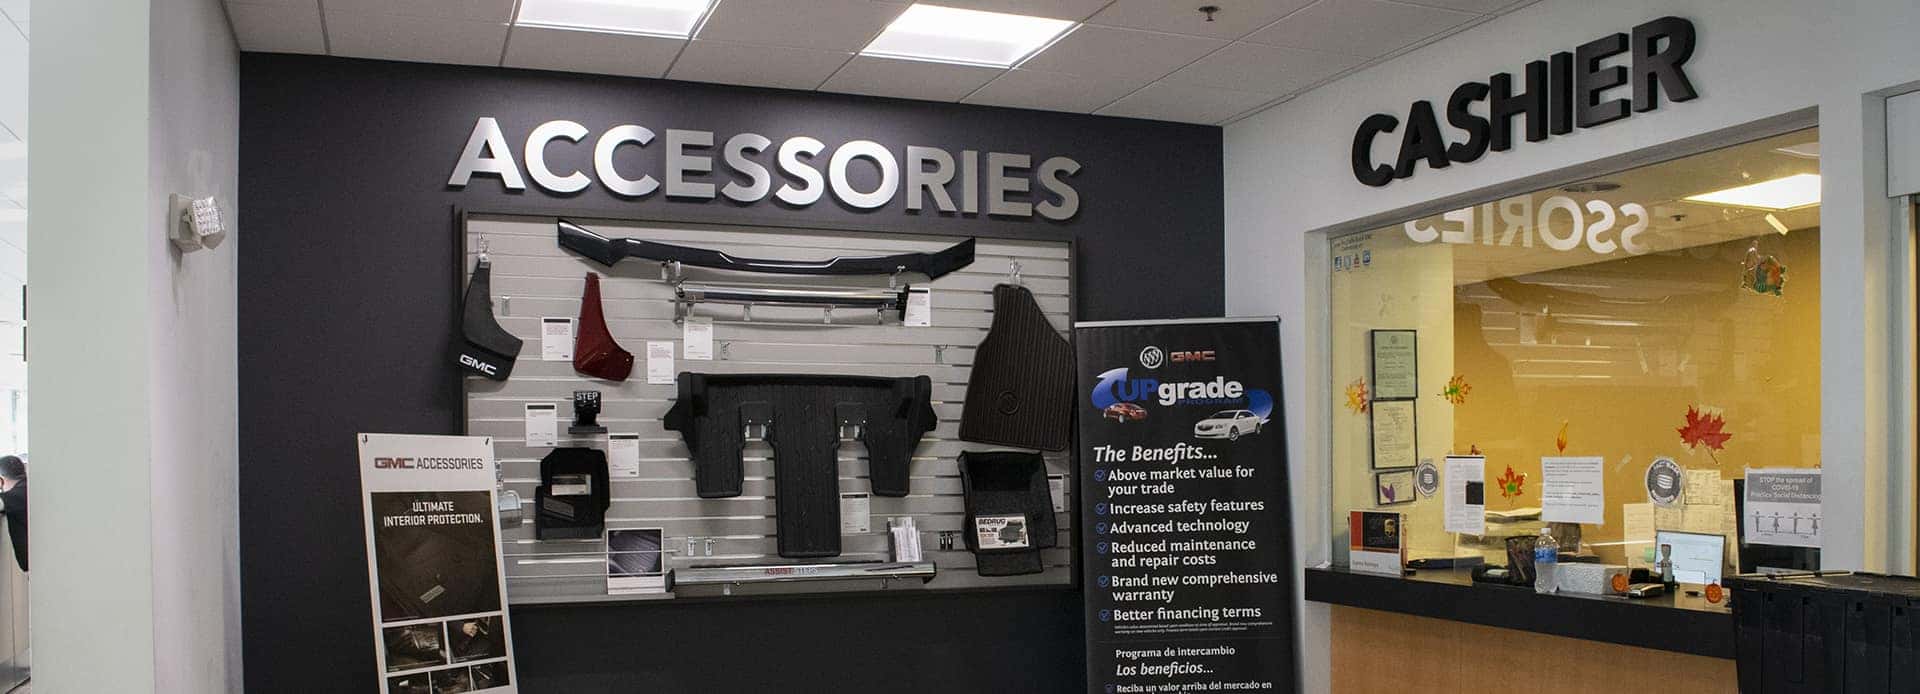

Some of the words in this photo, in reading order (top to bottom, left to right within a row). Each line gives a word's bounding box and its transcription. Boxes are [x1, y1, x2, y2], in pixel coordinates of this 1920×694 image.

[1352, 16, 1698, 186] CASHIER
[447, 117, 1081, 220] ACCESSORIES
[1170, 351, 1216, 363] GMC
[459, 354, 497, 376] GMC
[576, 391, 599, 400] STEP
[1094, 444, 1126, 463] The
[1131, 442, 1218, 465] Benefits...
[374, 457, 414, 469] GMC
[416, 457, 484, 469] ACCESSORIES
[1107, 469, 1147, 481] Above
[1150, 468, 1196, 480] market
[1198, 466, 1233, 479] value
[1235, 464, 1255, 478] for
[1107, 484, 1138, 498] your
[1140, 481, 1175, 495] trade
[412, 501, 455, 512] ULTIMATE
[1109, 503, 1165, 515] Increase
[1167, 500, 1207, 515] safety
[1210, 498, 1265, 512] features
[383, 515, 427, 527] INTERIOR
[427, 513, 484, 525] PROTECTION.
[1109, 520, 1174, 534] Advanced
[1176, 519, 1250, 534] technology
[1111, 540, 1166, 554] Reduced
[1170, 539, 1256, 552] maintenance
[1111, 555, 1136, 568] and
[1139, 553, 1180, 570] repair
[1182, 554, 1216, 566] costs
[1111, 574, 1149, 587] Brand
[1152, 575, 1179, 587] new
[1181, 571, 1278, 588] comprehensive
[1112, 589, 1175, 603] warranty
[1113, 609, 1154, 621] Better
[1157, 606, 1220, 621] financing
[1222, 607, 1262, 618] terms
[1115, 649, 1162, 660] Programa
[1164, 647, 1176, 657] de
[1177, 645, 1236, 657] intercambio
[1116, 664, 1137, 676] Los
[1140, 661, 1214, 678] beneficios...
[1116, 683, 1144, 693] Reciba
[1145, 684, 1157, 693] un
[1158, 682, 1181, 693] valor
[1181, 681, 1207, 691] arriba
[1208, 680, 1222, 690] del
[1223, 679, 1260, 690] mercado
[1261, 681, 1272, 689] en
